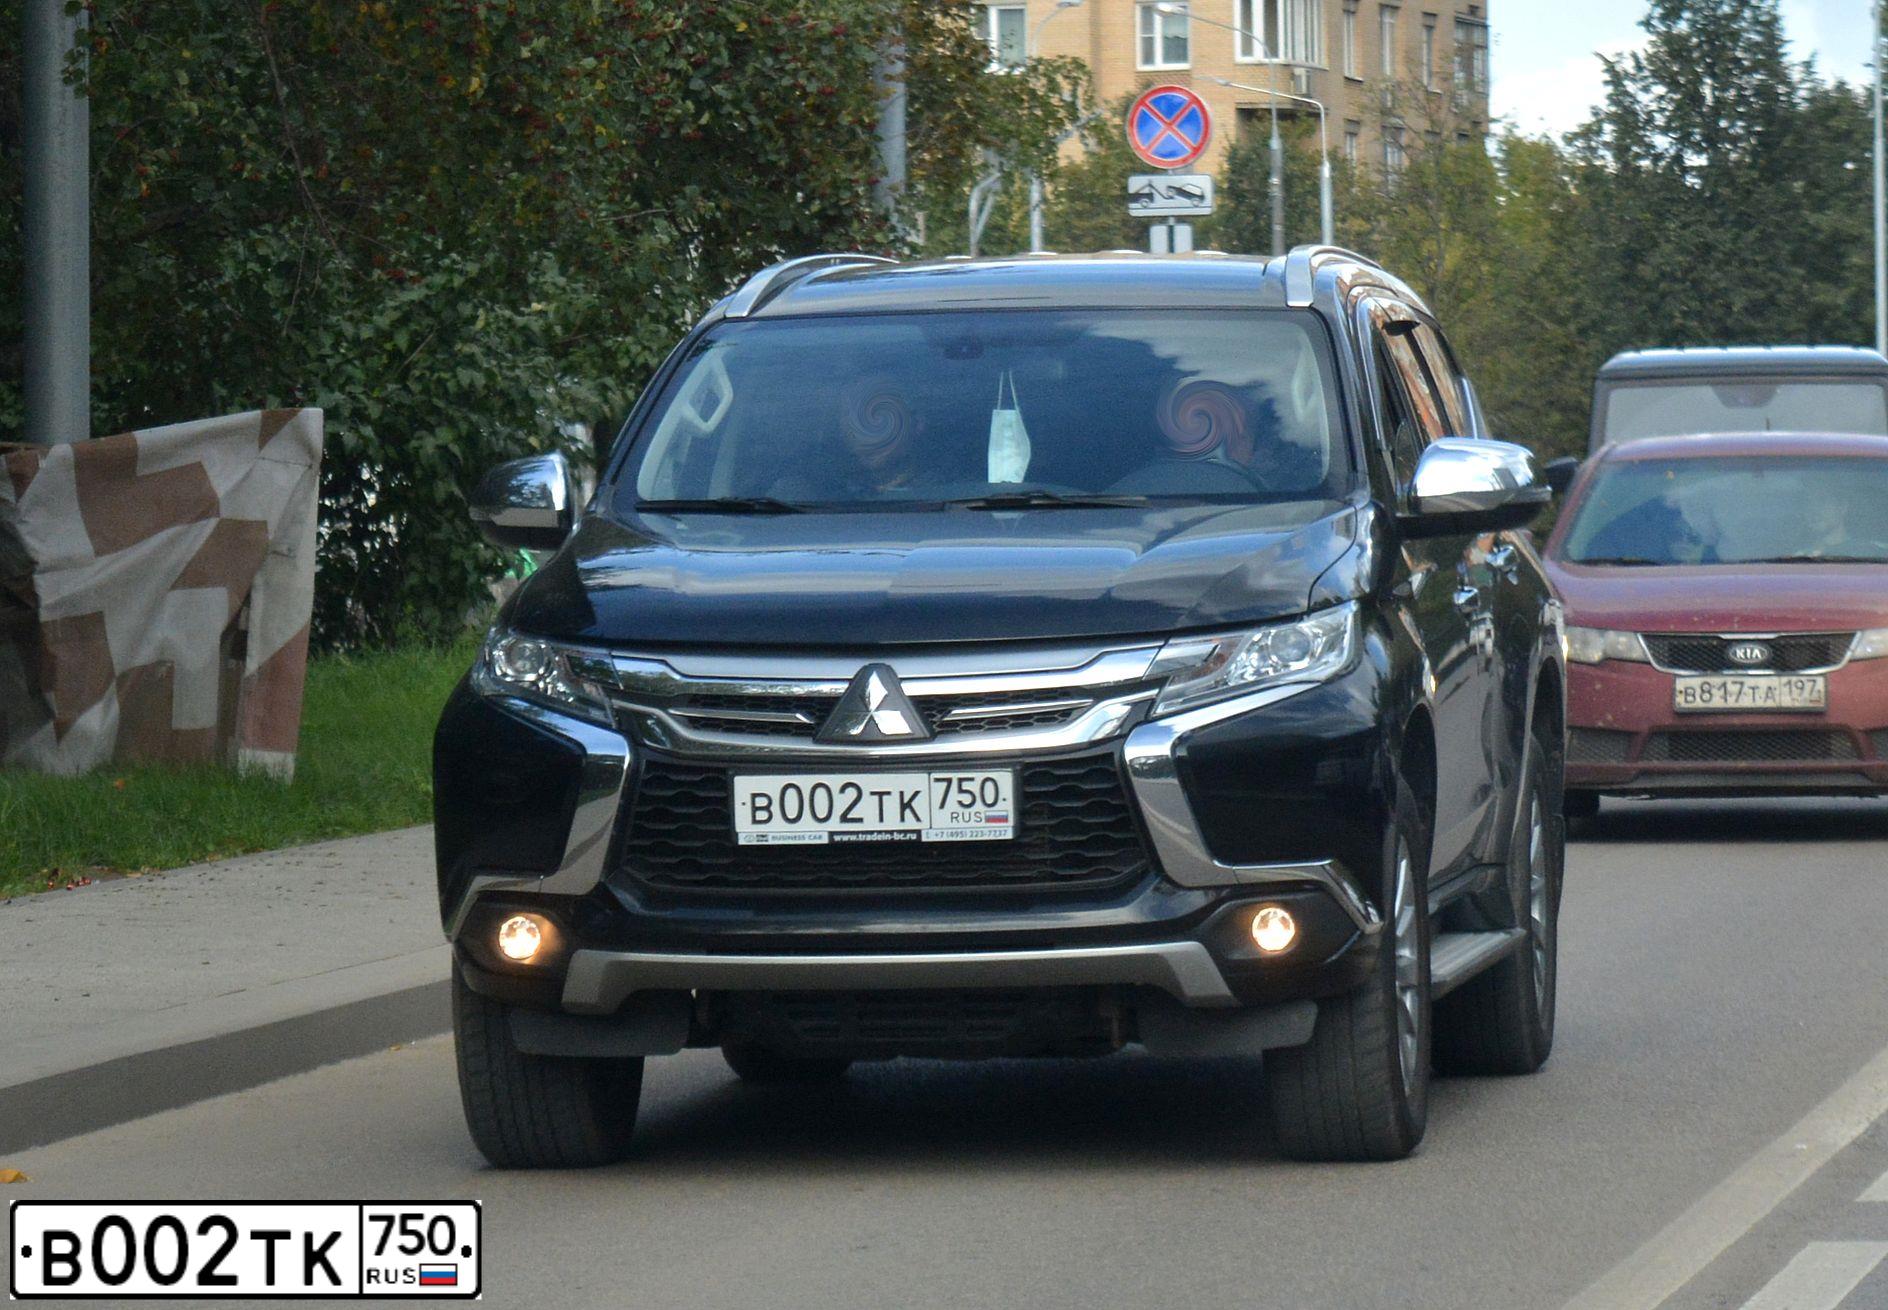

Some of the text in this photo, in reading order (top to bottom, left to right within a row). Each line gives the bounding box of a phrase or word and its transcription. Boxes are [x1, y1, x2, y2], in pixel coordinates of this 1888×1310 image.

[1735, 648, 1762, 659] KIA
[1783, 679, 1818, 696] 197
[749, 776, 1000, 825] В002ТК 750
[950, 811, 983, 824] RUS
